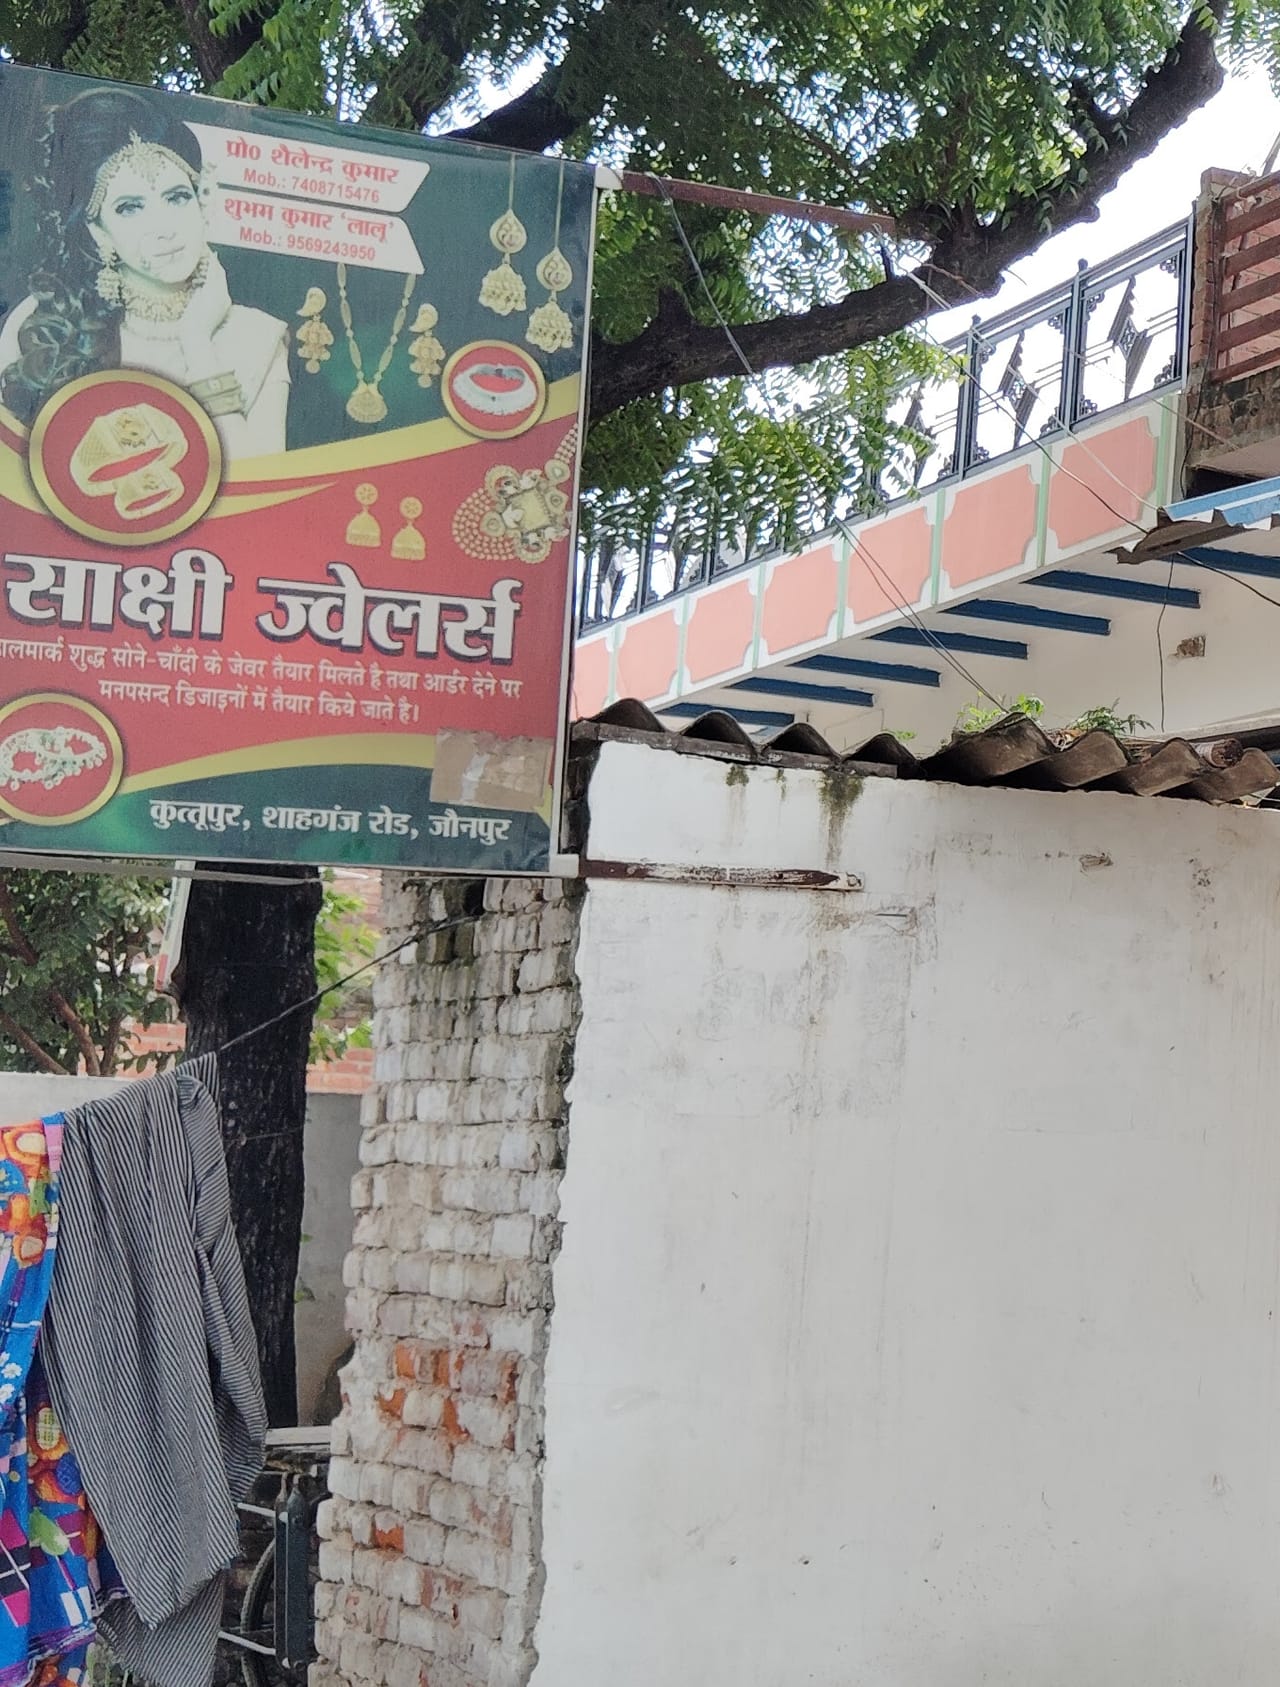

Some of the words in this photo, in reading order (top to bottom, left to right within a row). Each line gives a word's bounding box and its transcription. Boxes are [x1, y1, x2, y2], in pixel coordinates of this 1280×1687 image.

[271, 144, 334, 174] शैलेन्द्र
[341, 159, 399, 183] कुमार
[291, 175, 380, 203] 7408715476
[224, 198, 274, 221] शुभम
[281, 206, 334, 229] कुमार
[287, 234, 376, 261] 9569243950
[3, 548, 234, 640] साक्षी
[255, 560, 524, 664] ज्वेलर्स
[0, 635, 64, 663] ालमार्क
[68, 642, 107, 672] शुद्ध
[203, 650, 223, 675] के
[227, 651, 268, 678] जेवर
[272, 653, 313, 682] तैयार
[318, 657, 366, 687] मिलते
[369, 663, 384, 691] है
[386, 669, 420, 691] तथा
[423, 668, 469, 694] आर्डर
[471, 670, 497, 699] देने
[500, 678, 523, 700] पर
[98, 679, 171, 707] मनपसन्द
[175, 678, 248, 713] डिजाइनों
[252, 683, 269, 711] में
[272, 685, 314, 714] तैयार
[318, 690, 355, 717] किये
[360, 694, 395, 721] जाते
[262, 804, 362, 833] शाहगंज
[368, 805, 419, 842] रोड,
[428, 808, 512, 846] जौनपुर
